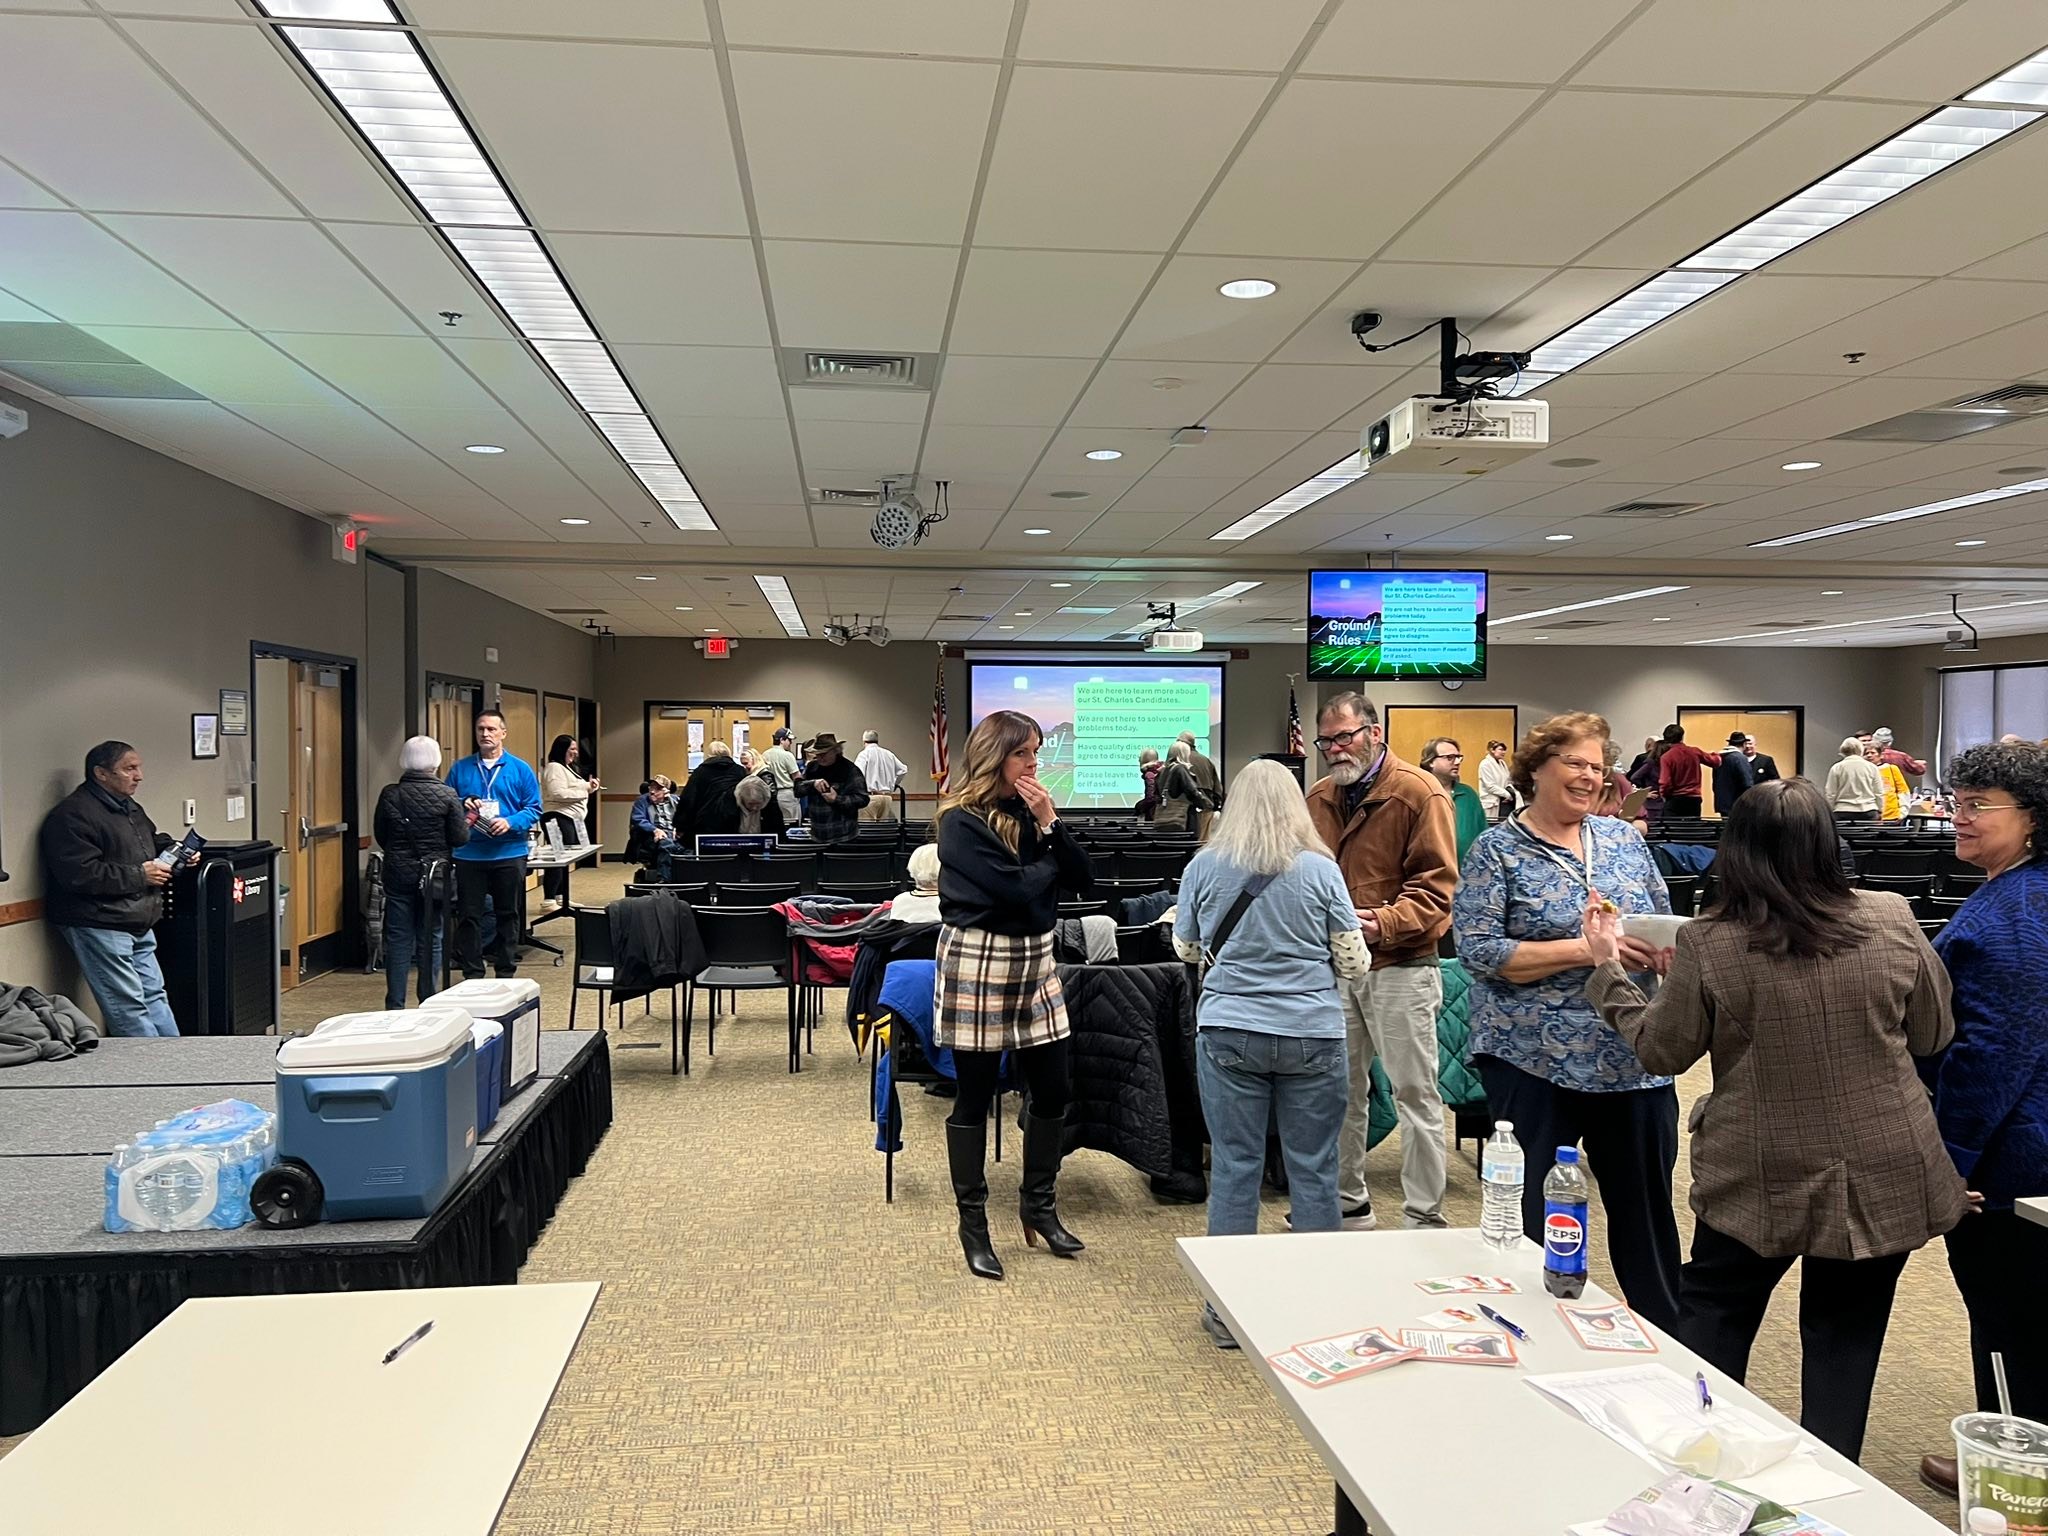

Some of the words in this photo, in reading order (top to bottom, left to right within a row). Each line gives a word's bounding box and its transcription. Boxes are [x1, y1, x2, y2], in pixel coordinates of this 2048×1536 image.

[1328, 620, 1370, 630] Ground
[708, 639, 726, 653] EXIT
[1328, 635, 1361, 646] Rules
[1547, 1226, 1580, 1240] PEPSI
